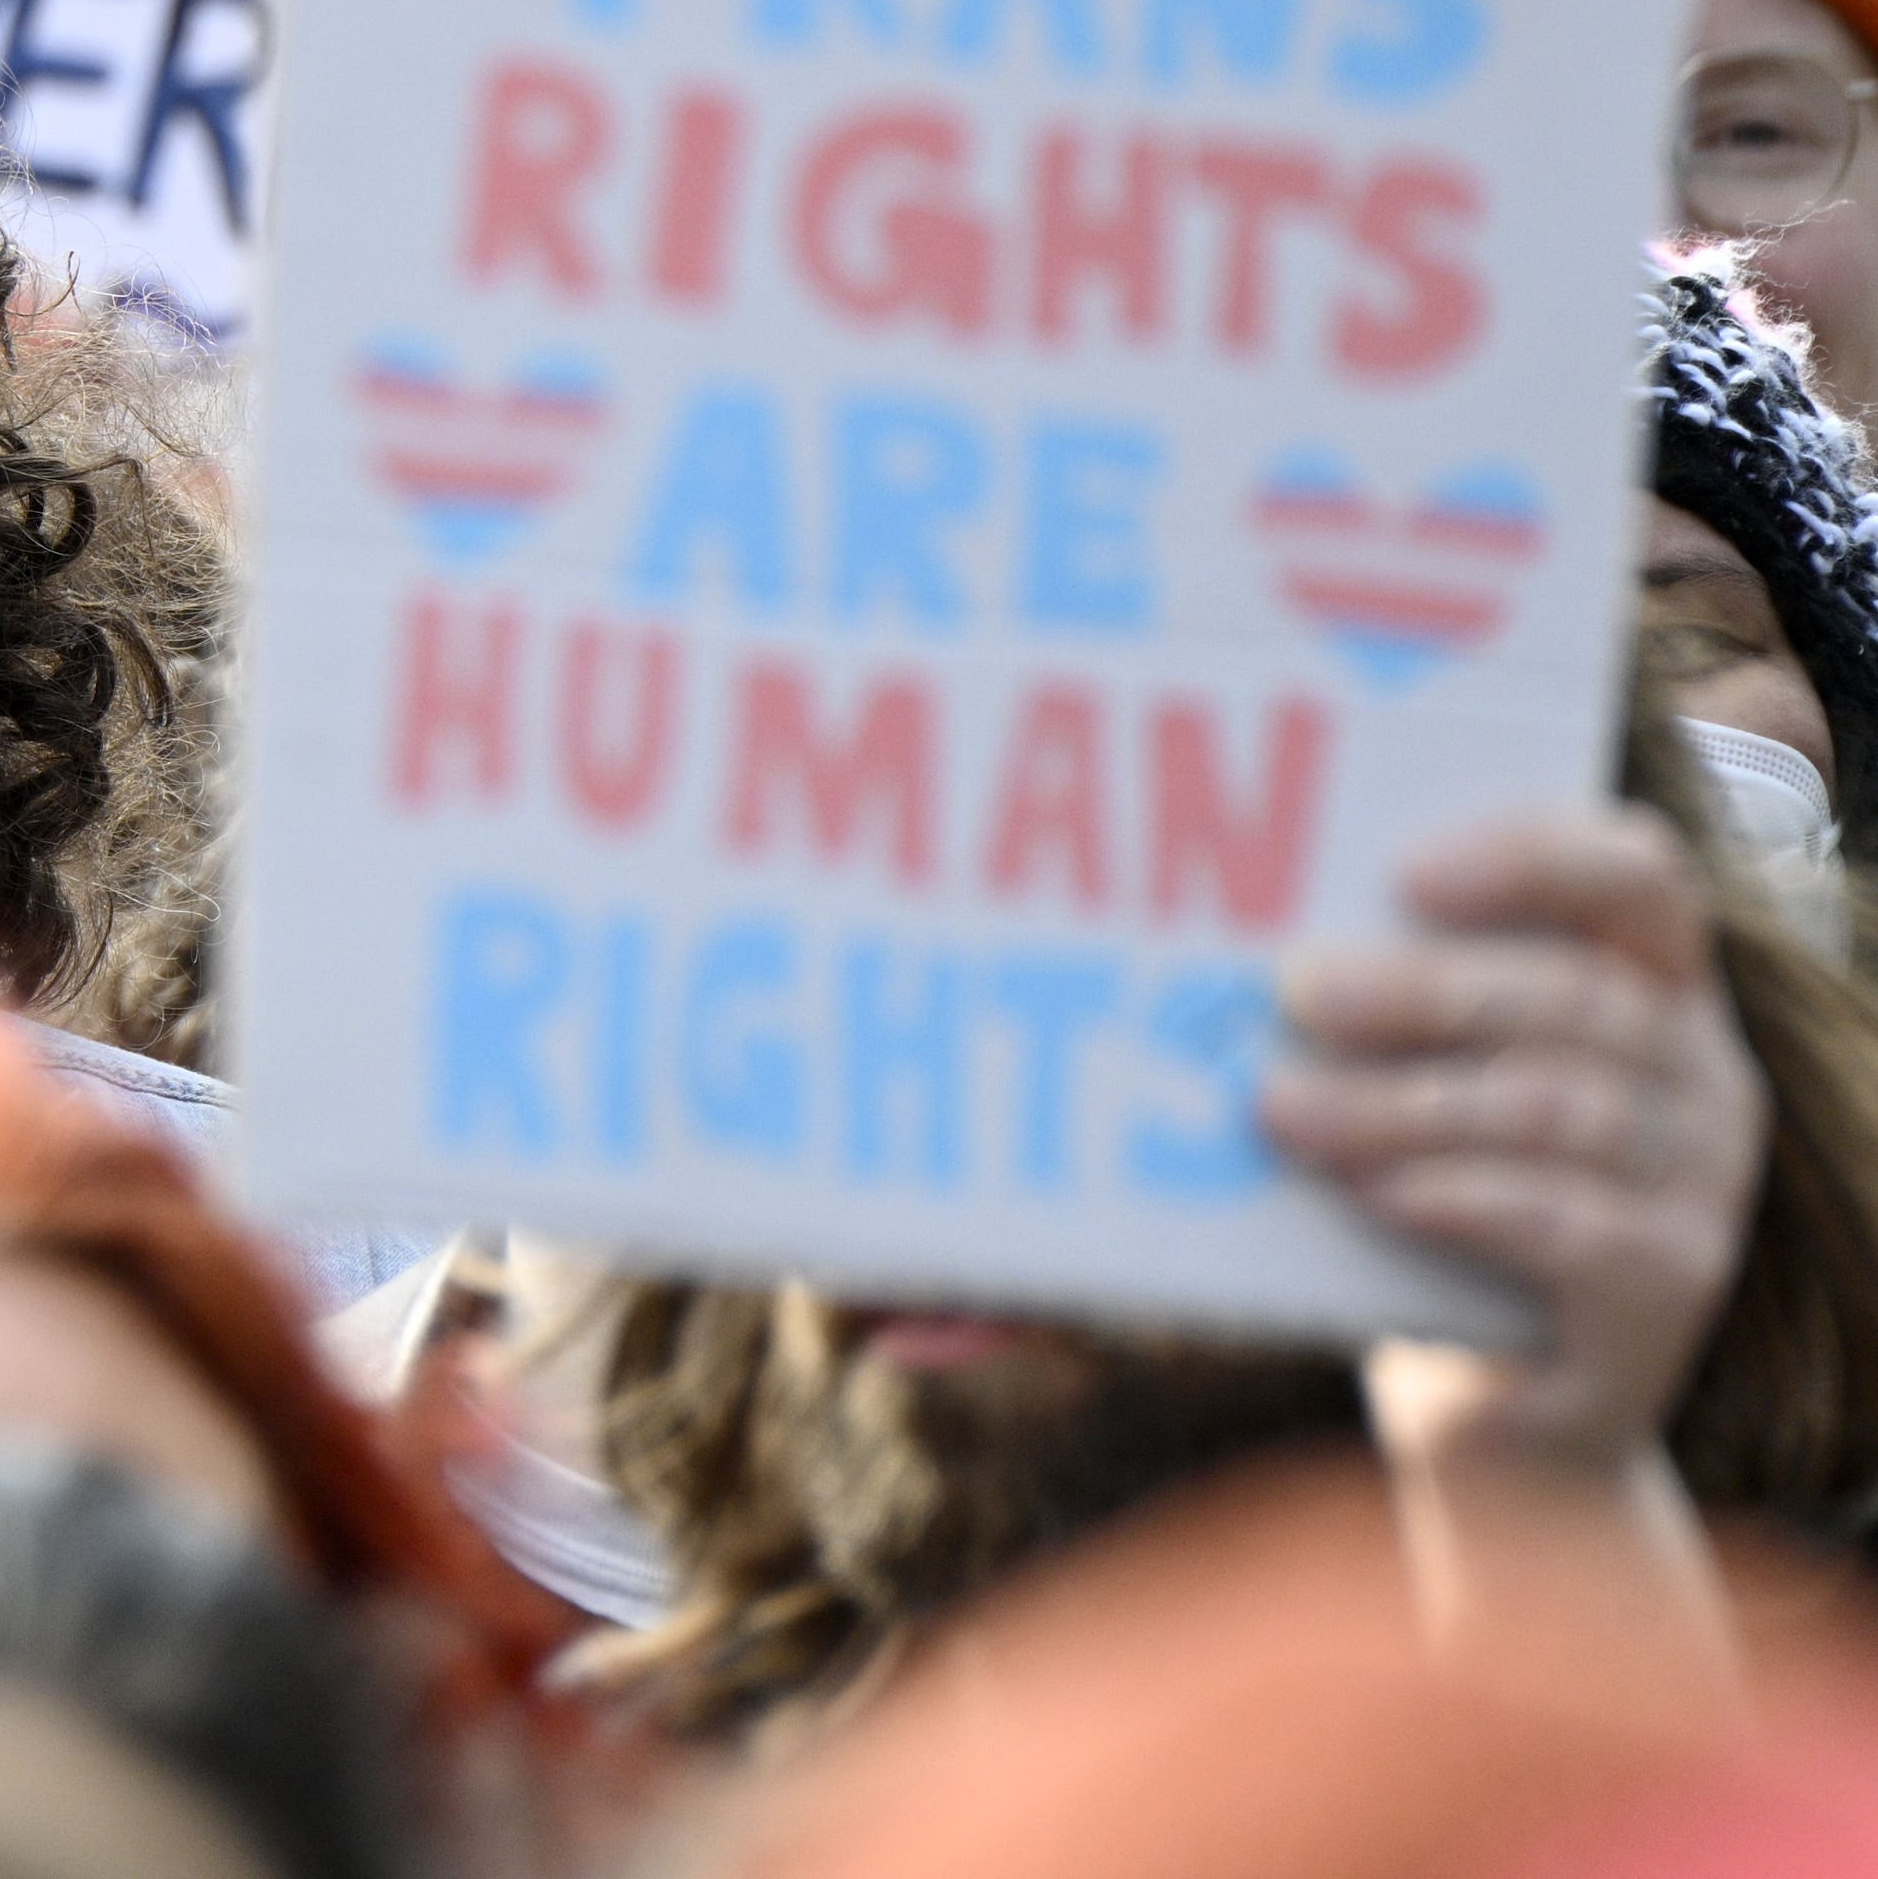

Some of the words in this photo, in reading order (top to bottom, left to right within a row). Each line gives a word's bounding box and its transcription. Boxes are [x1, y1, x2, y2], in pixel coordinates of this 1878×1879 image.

[459, 60, 1493, 386] RIGHTS
[621, 382, 1169, 630] ARE
[385, 590, 1339, 944] HUMAN
[429, 885, 1285, 1198] RIGHTS
